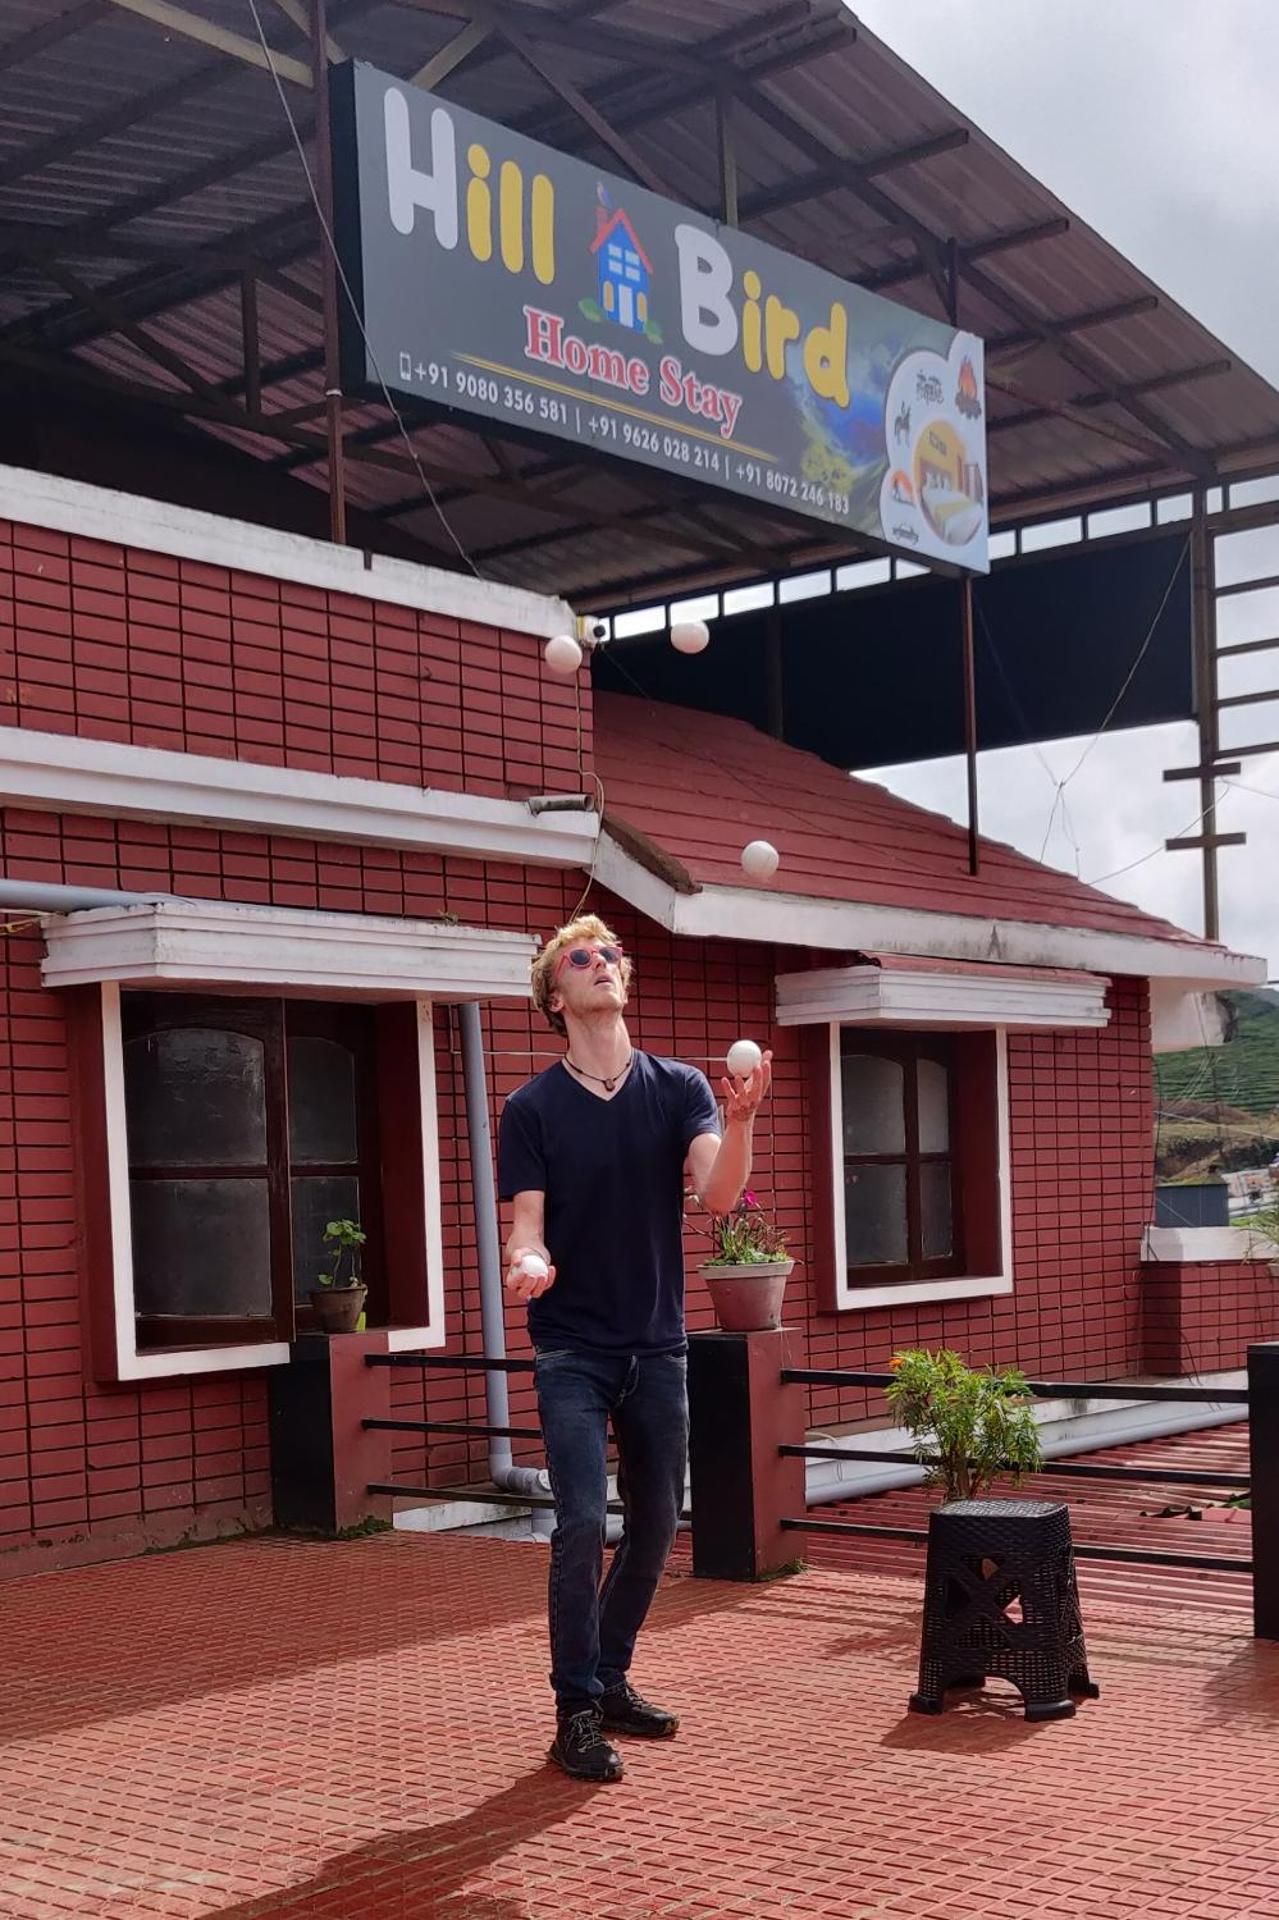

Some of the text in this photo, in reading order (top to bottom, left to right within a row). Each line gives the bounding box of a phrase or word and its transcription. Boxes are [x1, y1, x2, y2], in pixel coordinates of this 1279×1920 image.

[384, 87, 849, 408] Hill Bird
[415, 362, 448, 388] +91
[456, 371, 498, 404] 9080
[504, 386, 534, 414] 356
[539, 397, 567, 425] 581
[588, 415, 617, 440] +91
[623, 424, 659, 453] 9626
[663, 436, 690, 463] 028
[694, 446, 720, 472] 214
[736, 463, 760, 486] +91
[766, 469, 798, 498] 8072
[801, 481, 824, 506] 246
[828, 491, 849, 515] 183
[523, 304, 742, 439] Home Stay
